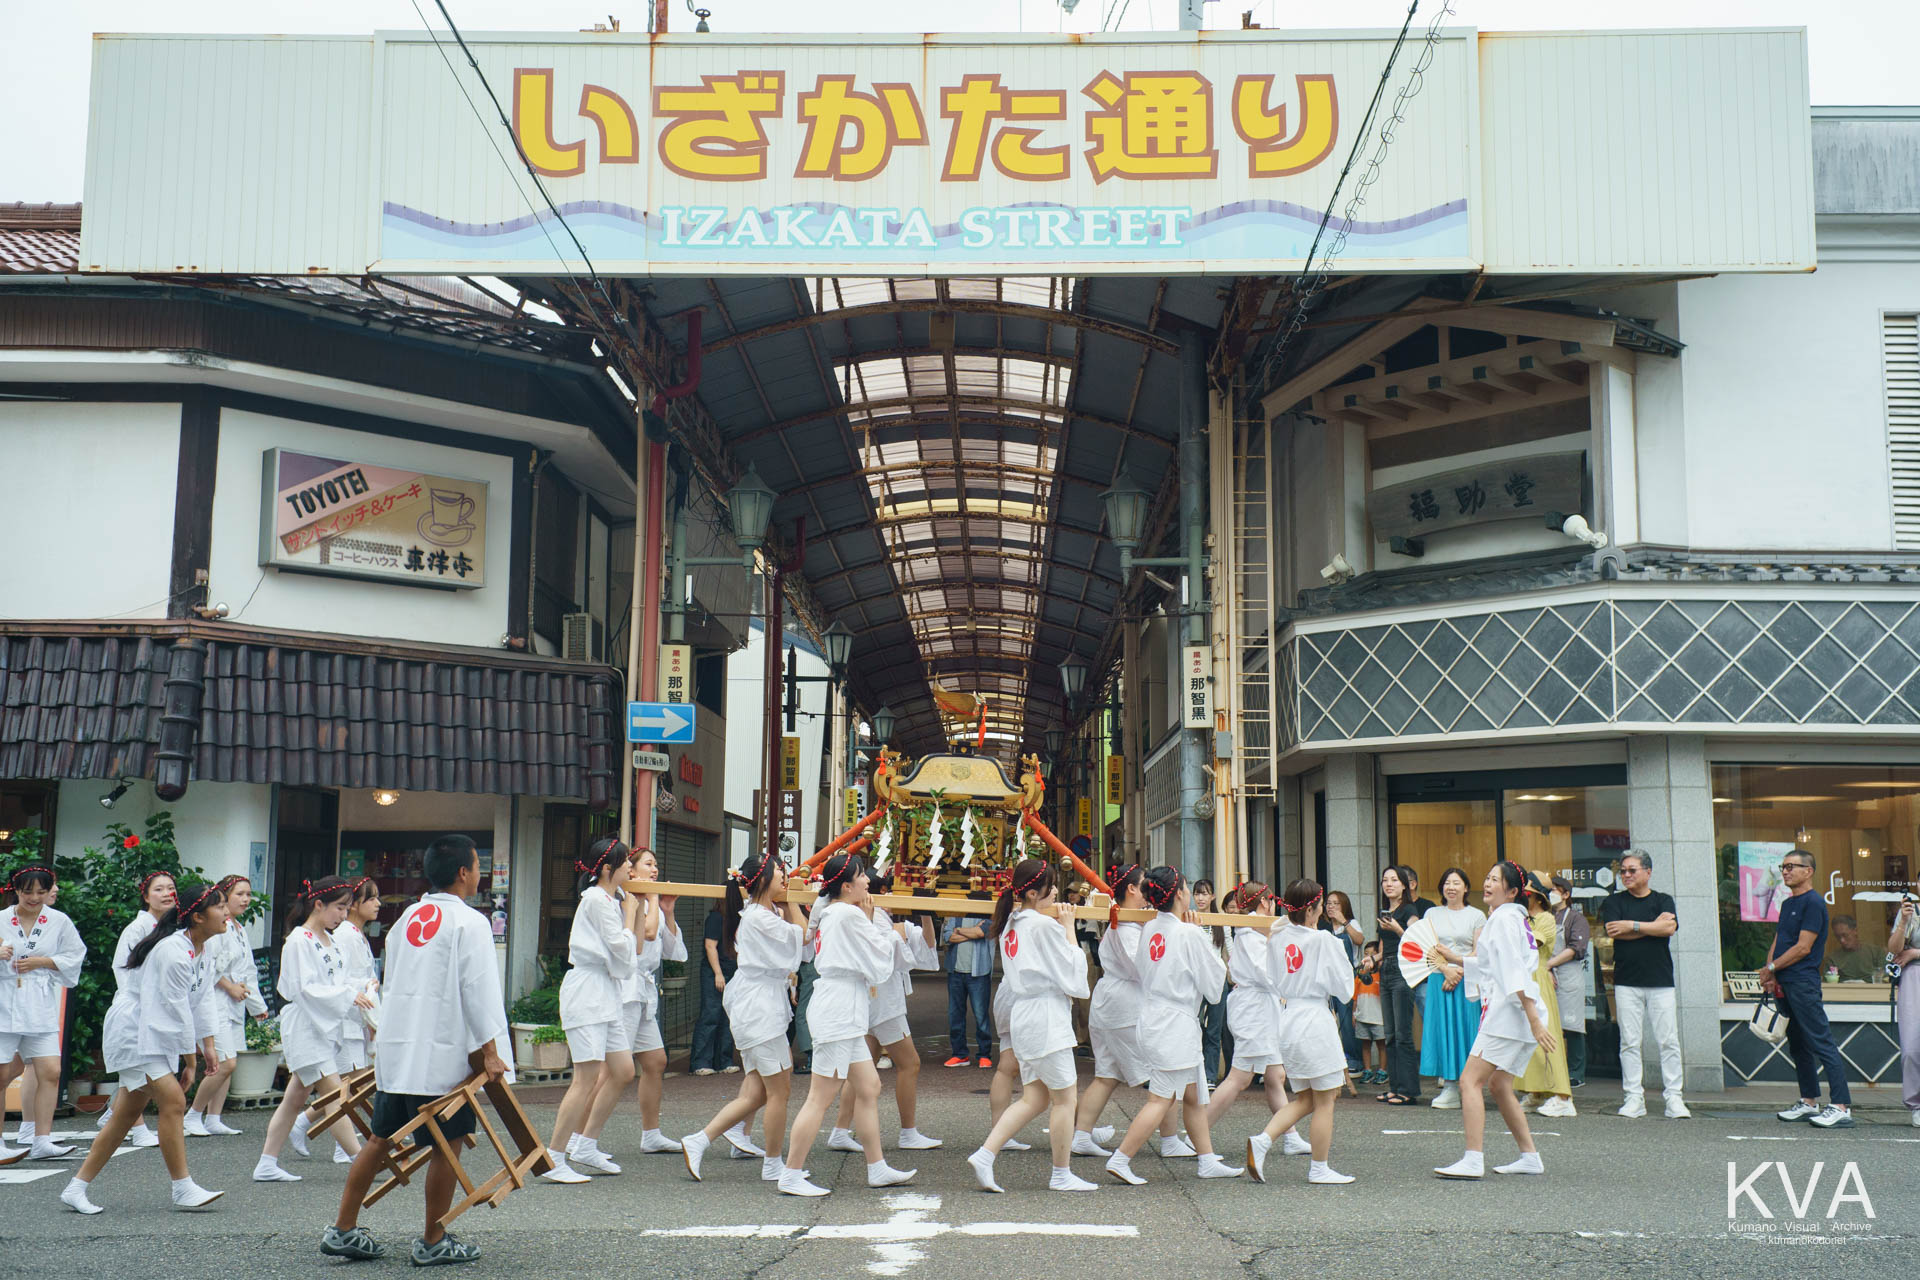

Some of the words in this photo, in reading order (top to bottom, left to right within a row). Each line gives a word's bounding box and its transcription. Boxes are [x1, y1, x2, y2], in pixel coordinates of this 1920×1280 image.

[513, 68, 1339, 186] いざかた通り
[659, 205, 937, 250] IZAKATA
[960, 205, 1192, 250] STREET
[286, 468, 370, 518] TOYOTEI
[1409, 473, 1536, 522] 福助堂
[334, 552, 400, 568] コーヒーハウス
[403, 545, 474, 578] 東洋亭
[1190, 677, 1206, 720] 那智黒
